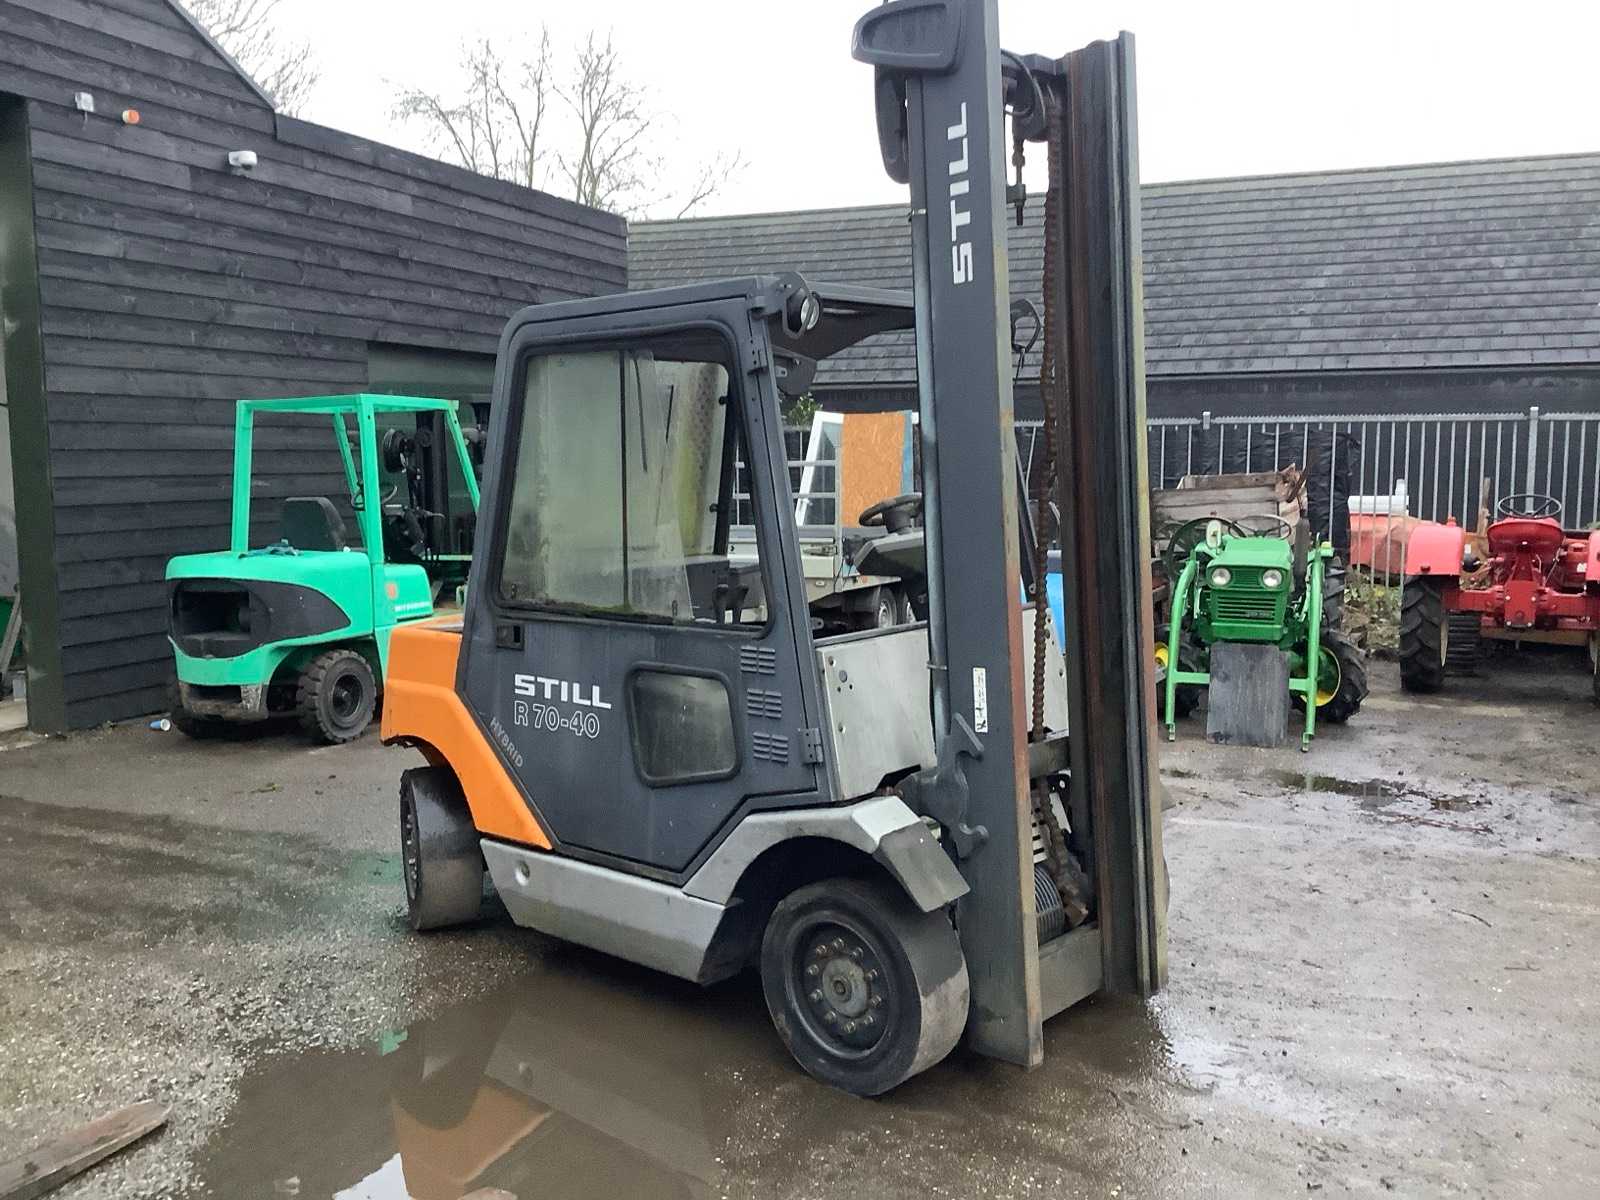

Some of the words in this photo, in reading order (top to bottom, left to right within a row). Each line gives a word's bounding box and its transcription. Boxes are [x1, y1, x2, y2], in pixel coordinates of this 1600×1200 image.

[947, 102, 974, 285] STILL
[514, 673, 612, 710] STILL
[490, 716, 524, 768] HYBRID
[514, 700, 529, 727] R
[532, 703, 600, 739] 70-40
